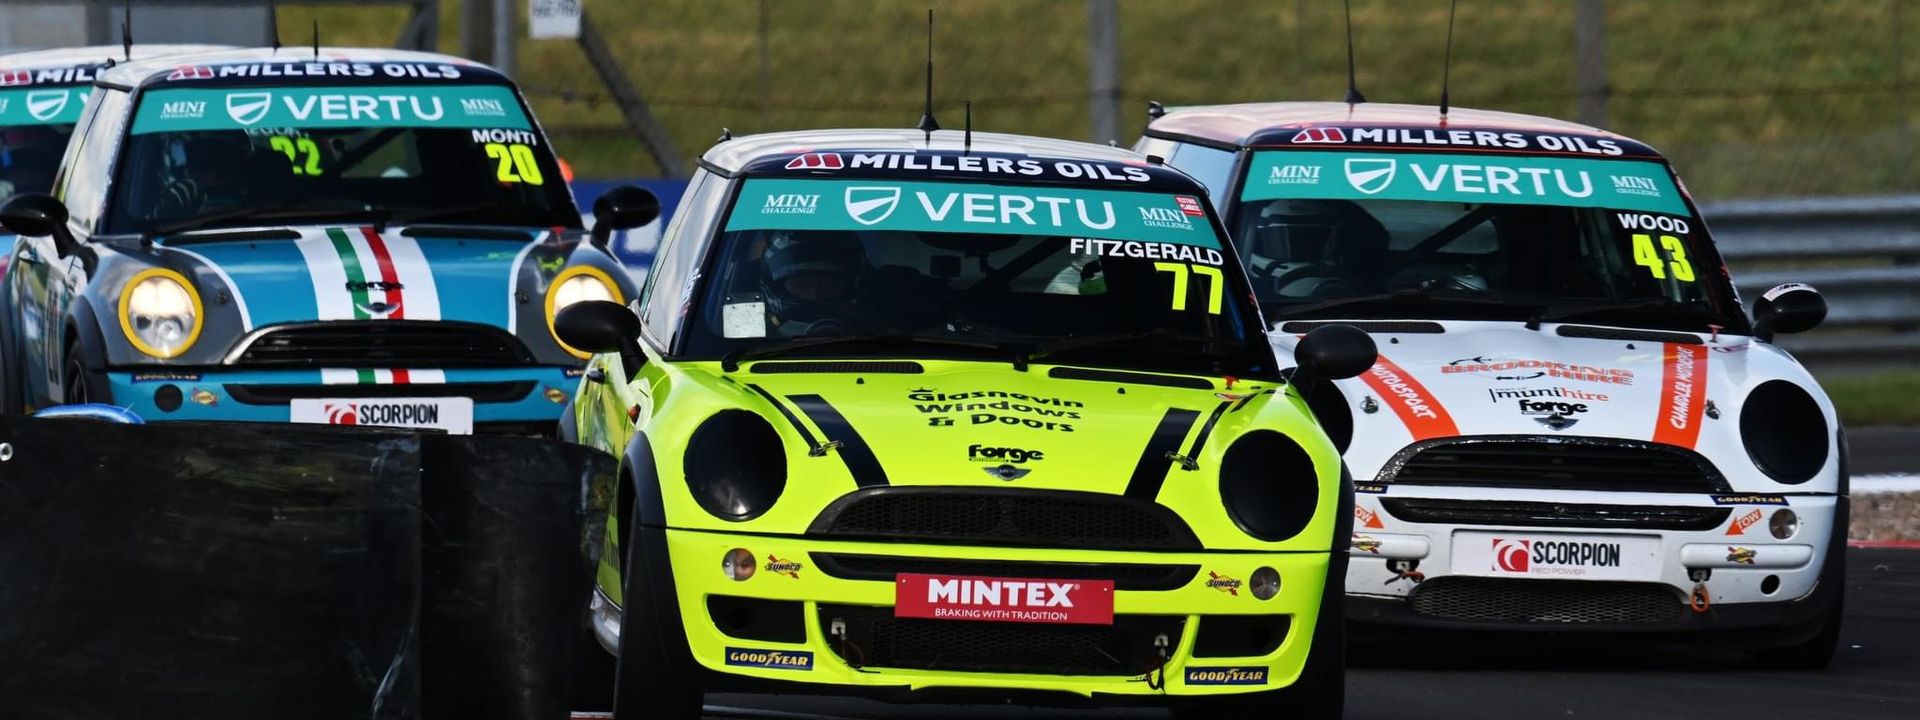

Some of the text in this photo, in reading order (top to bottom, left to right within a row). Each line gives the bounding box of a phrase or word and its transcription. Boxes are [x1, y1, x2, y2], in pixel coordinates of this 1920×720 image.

[219, 62, 461, 79] MILLERS OILS
[162, 101, 207, 114] MINI
[282, 95, 444, 121] VERTU
[461, 99, 504, 112] MINI
[472, 129, 537, 146] MONTI
[1352, 128, 1624, 156] MILLERS OILS
[485, 143, 543, 185] 20
[850, 153, 1151, 183] MILLERS OILS
[1270, 165, 1321, 179] MINI
[1409, 163, 1594, 198] VERTU
[1610, 174, 1658, 192] MINI
[761, 206, 816, 214] CHALLENGE
[764, 194, 821, 208] MINI
[915, 190, 1117, 231] VERTU
[1138, 206, 1191, 224] MINI
[1617, 213, 1689, 235] WOOD
[1070, 238, 1224, 266] FITZGERALD
[1631, 233, 1696, 283] 43
[1153, 261, 1224, 315] 77
[908, 391, 1084, 408] Glasnevin
[1370, 363, 1437, 420] MOTORSPORT
[360, 403, 438, 424] SCORPION
[914, 401, 1082, 420] Windows
[1669, 379, 1693, 430] CHANDLER
[971, 413, 1075, 432] Doors
[968, 444, 1044, 464] Forge
[1735, 509, 1760, 530] TOW
[1532, 540, 1620, 567] SCORPION
[928, 578, 1074, 608] MINTEX
[935, 607, 1068, 621] BRAKING WITH TRADITION
